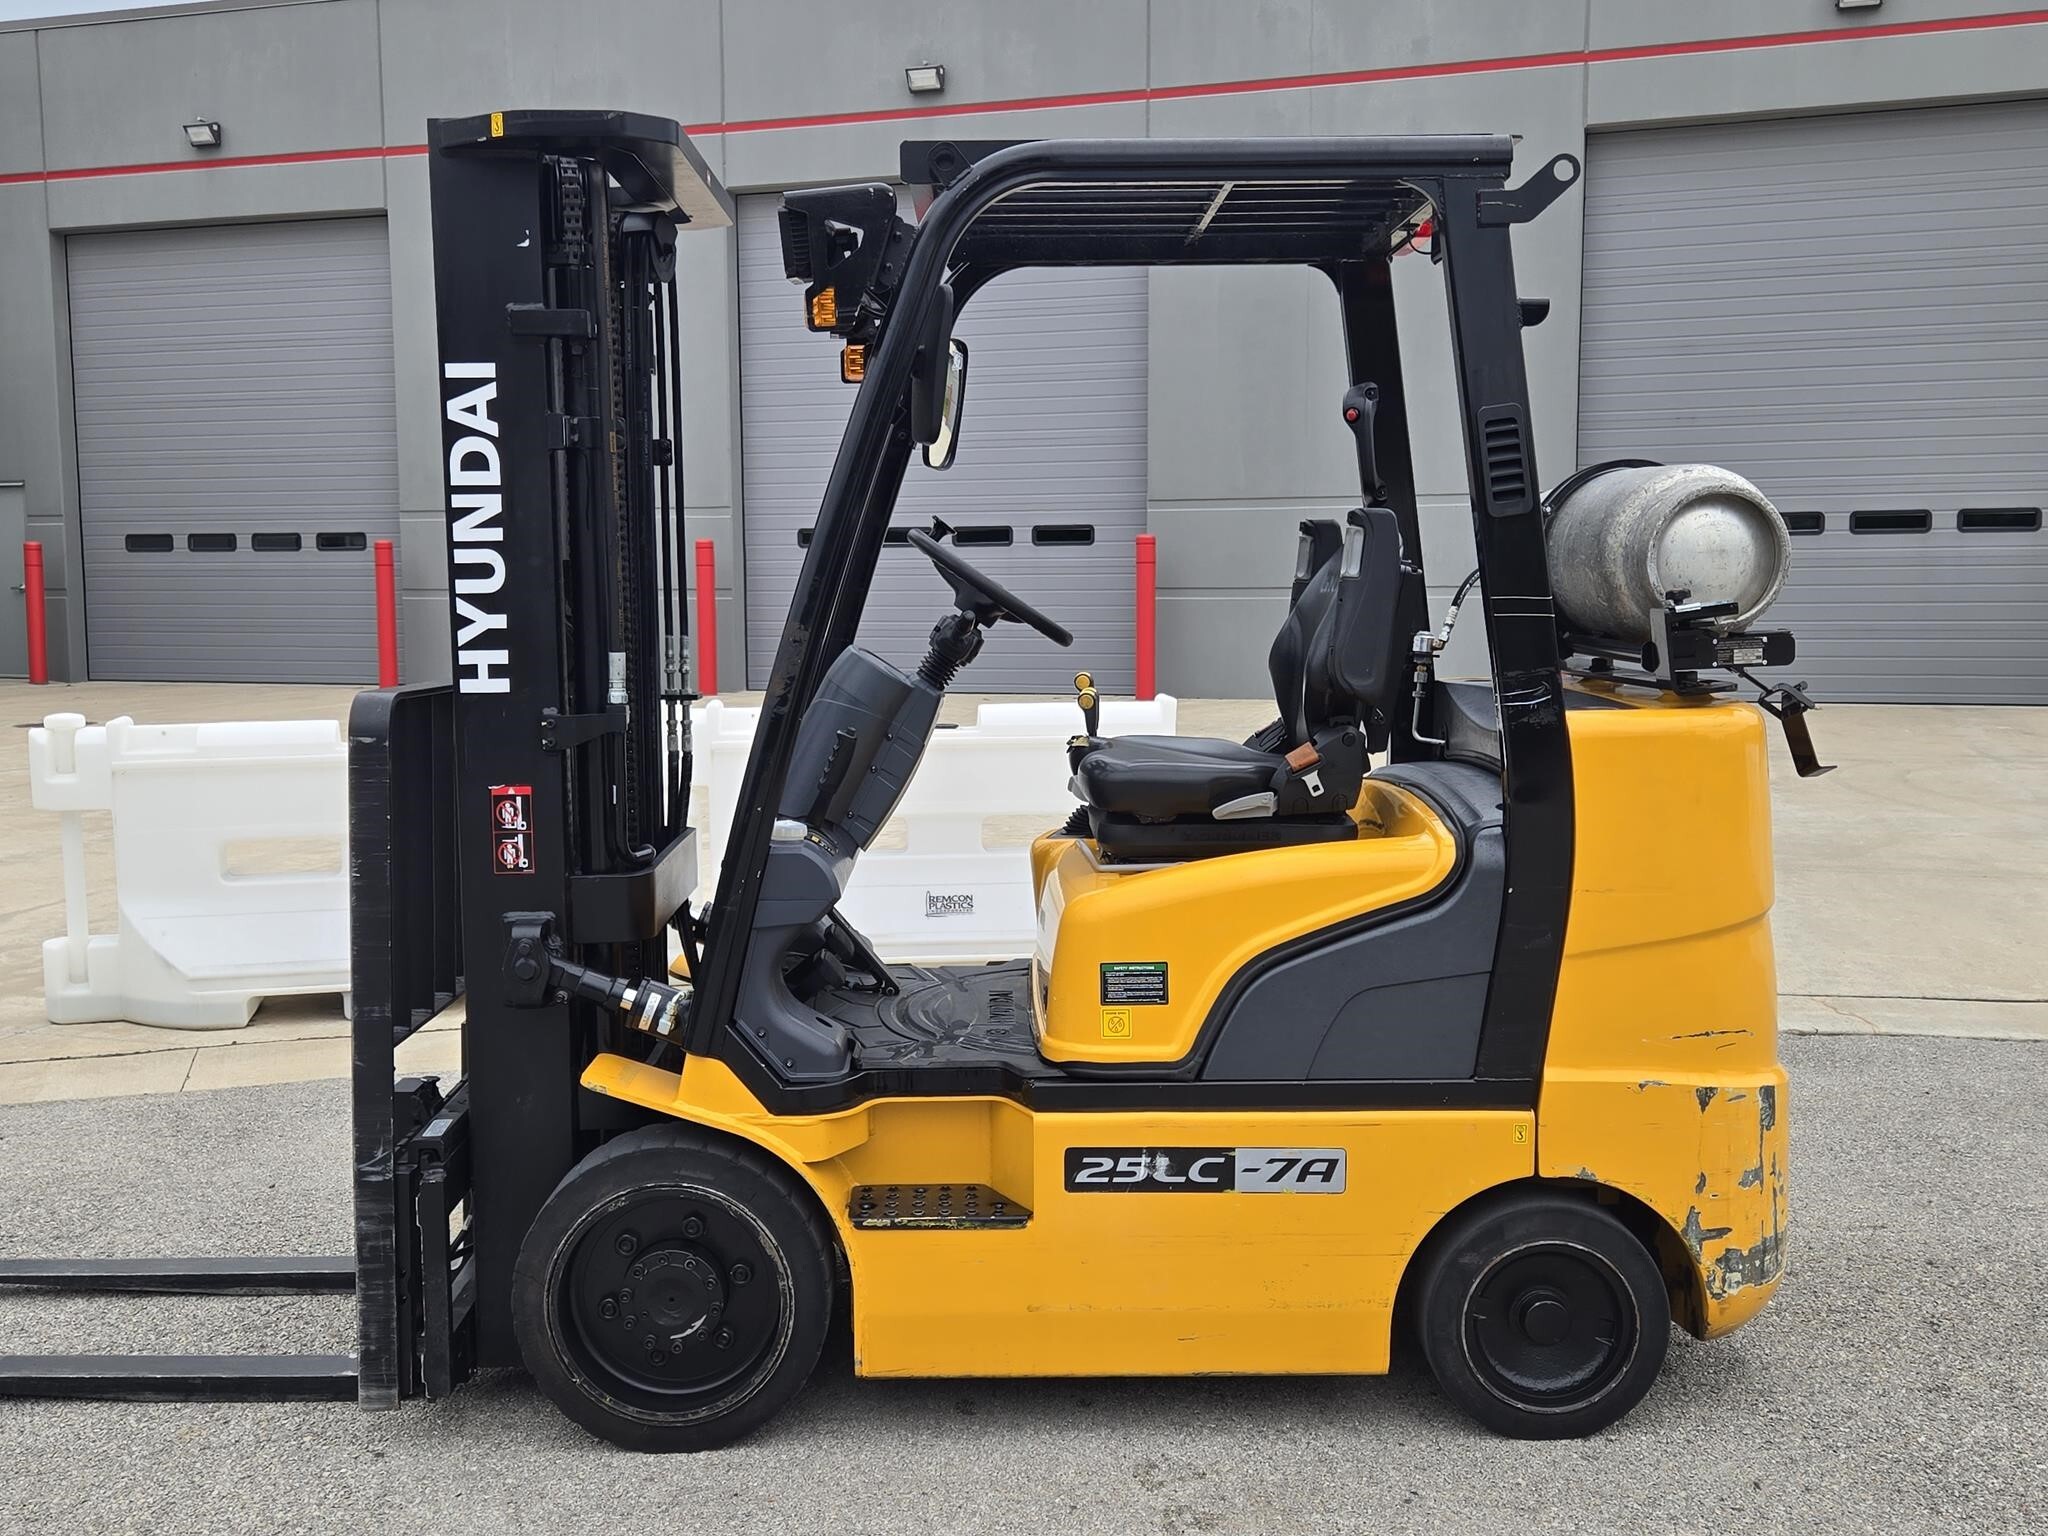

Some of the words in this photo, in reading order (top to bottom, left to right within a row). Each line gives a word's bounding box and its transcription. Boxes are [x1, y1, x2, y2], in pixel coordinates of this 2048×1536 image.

[444, 362, 511, 694] HYUNDAI
[929, 894, 974, 903] REMCON
[928, 902, 974, 910] PLASTICS
